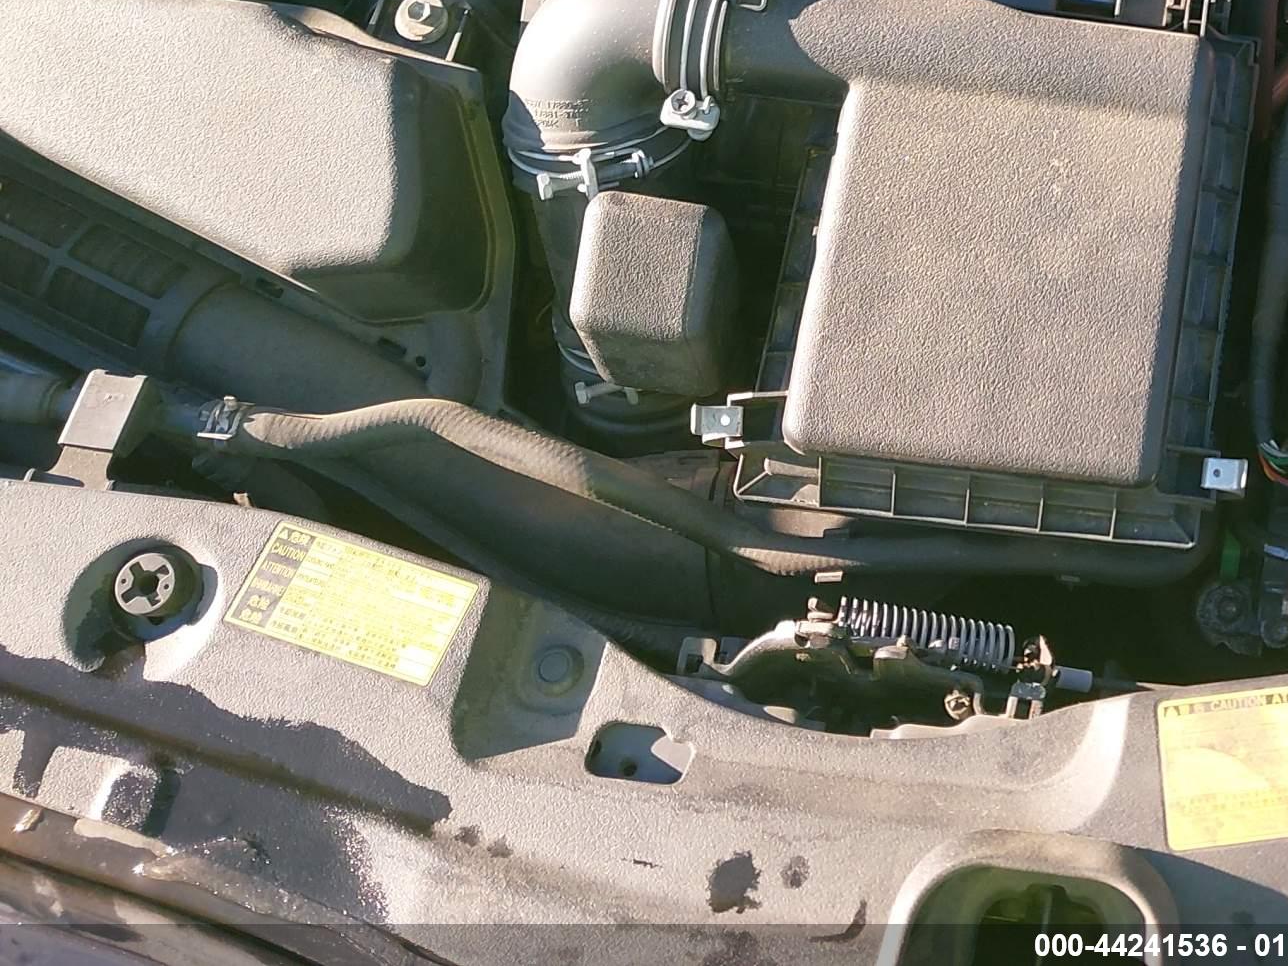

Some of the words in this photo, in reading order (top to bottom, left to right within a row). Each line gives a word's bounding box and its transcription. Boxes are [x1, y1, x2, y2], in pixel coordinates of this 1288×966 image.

[271, 542, 307, 562] CAUTION
[261, 560, 298, 579] ATTENTION
[1210, 694, 1266, 711] CAUTION
